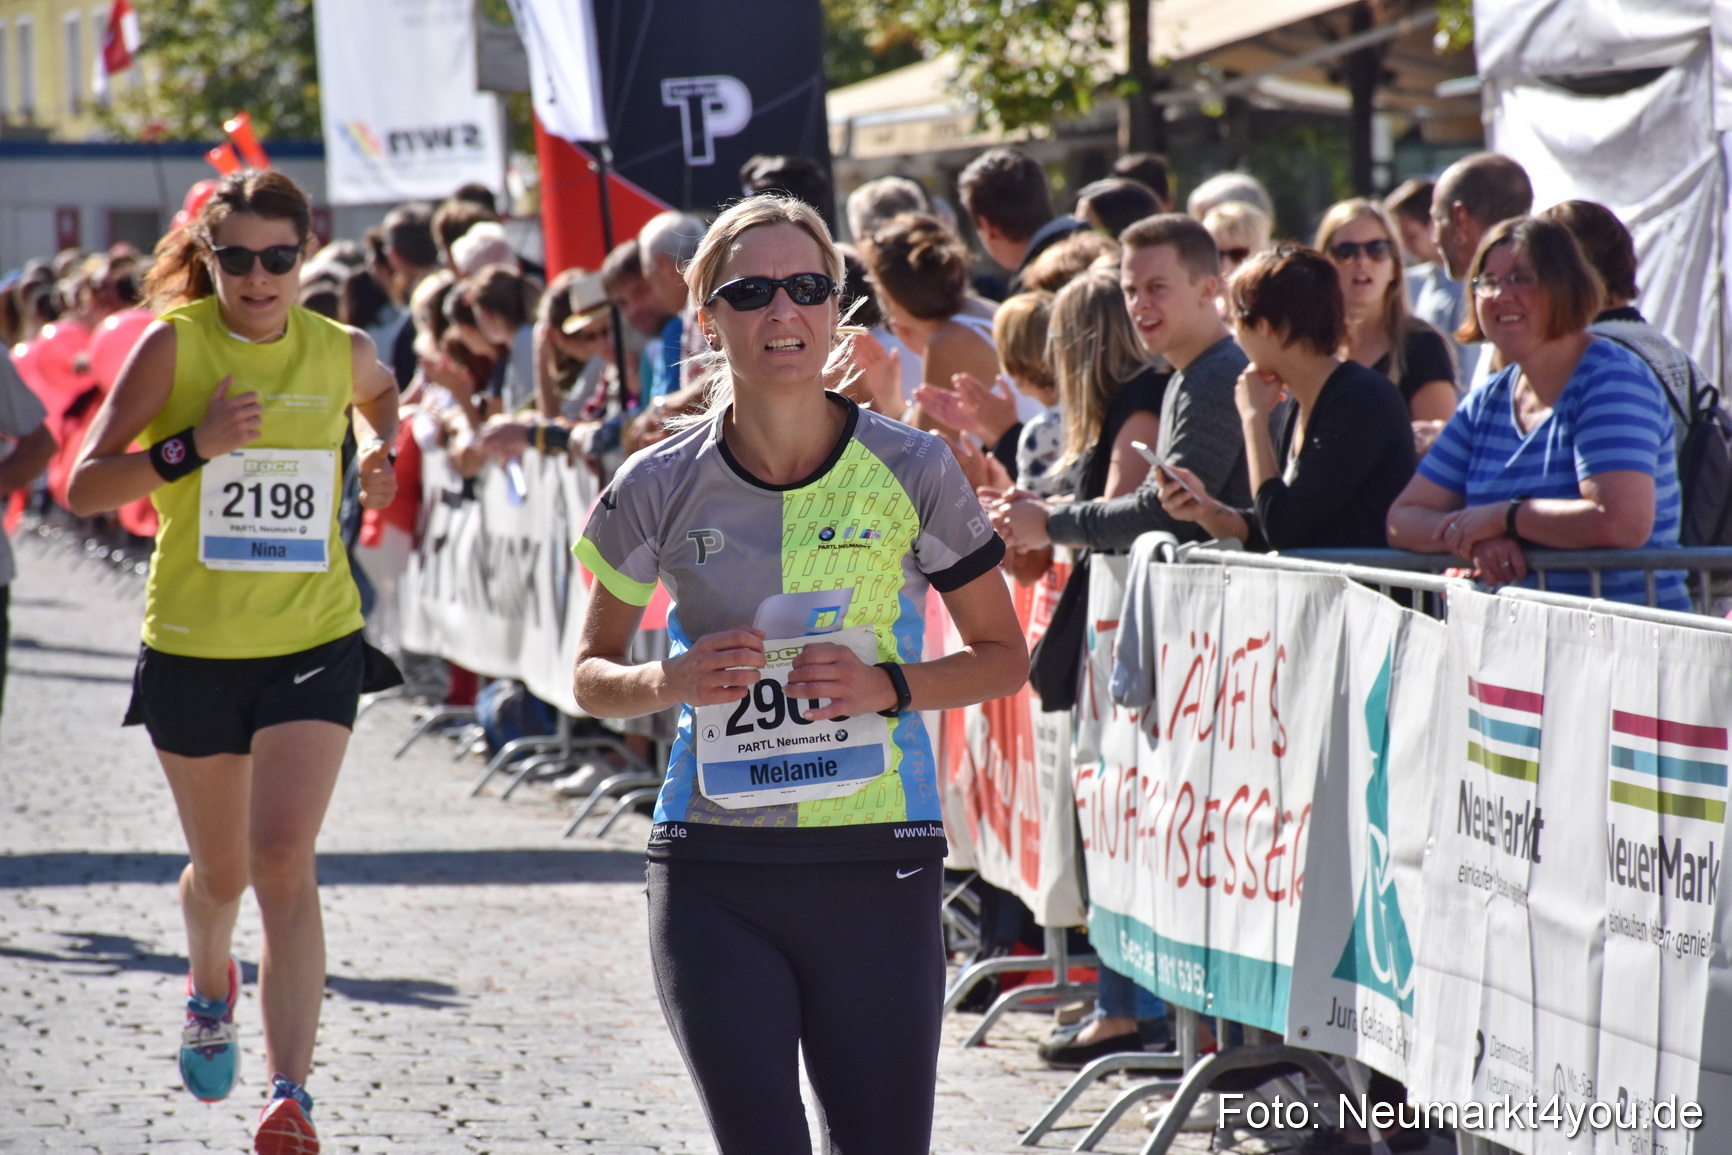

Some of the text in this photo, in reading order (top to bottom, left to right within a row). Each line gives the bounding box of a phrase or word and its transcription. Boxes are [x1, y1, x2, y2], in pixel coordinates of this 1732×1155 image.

[222, 482, 315, 520] 2198
[230, 524, 297, 534] PARTL Neumarkt
[251, 542, 287, 558] Nina
[725, 678, 852, 737] 290
[707, 729, 714, 739] A
[737, 733, 831, 754] PARTL Neumarkt
[750, 756, 838, 786] Melanie
[893, 823, 945, 839] www.bm
[1608, 907, 1648, 942] einkaufen
[1326, 996, 1357, 1033] Jura
